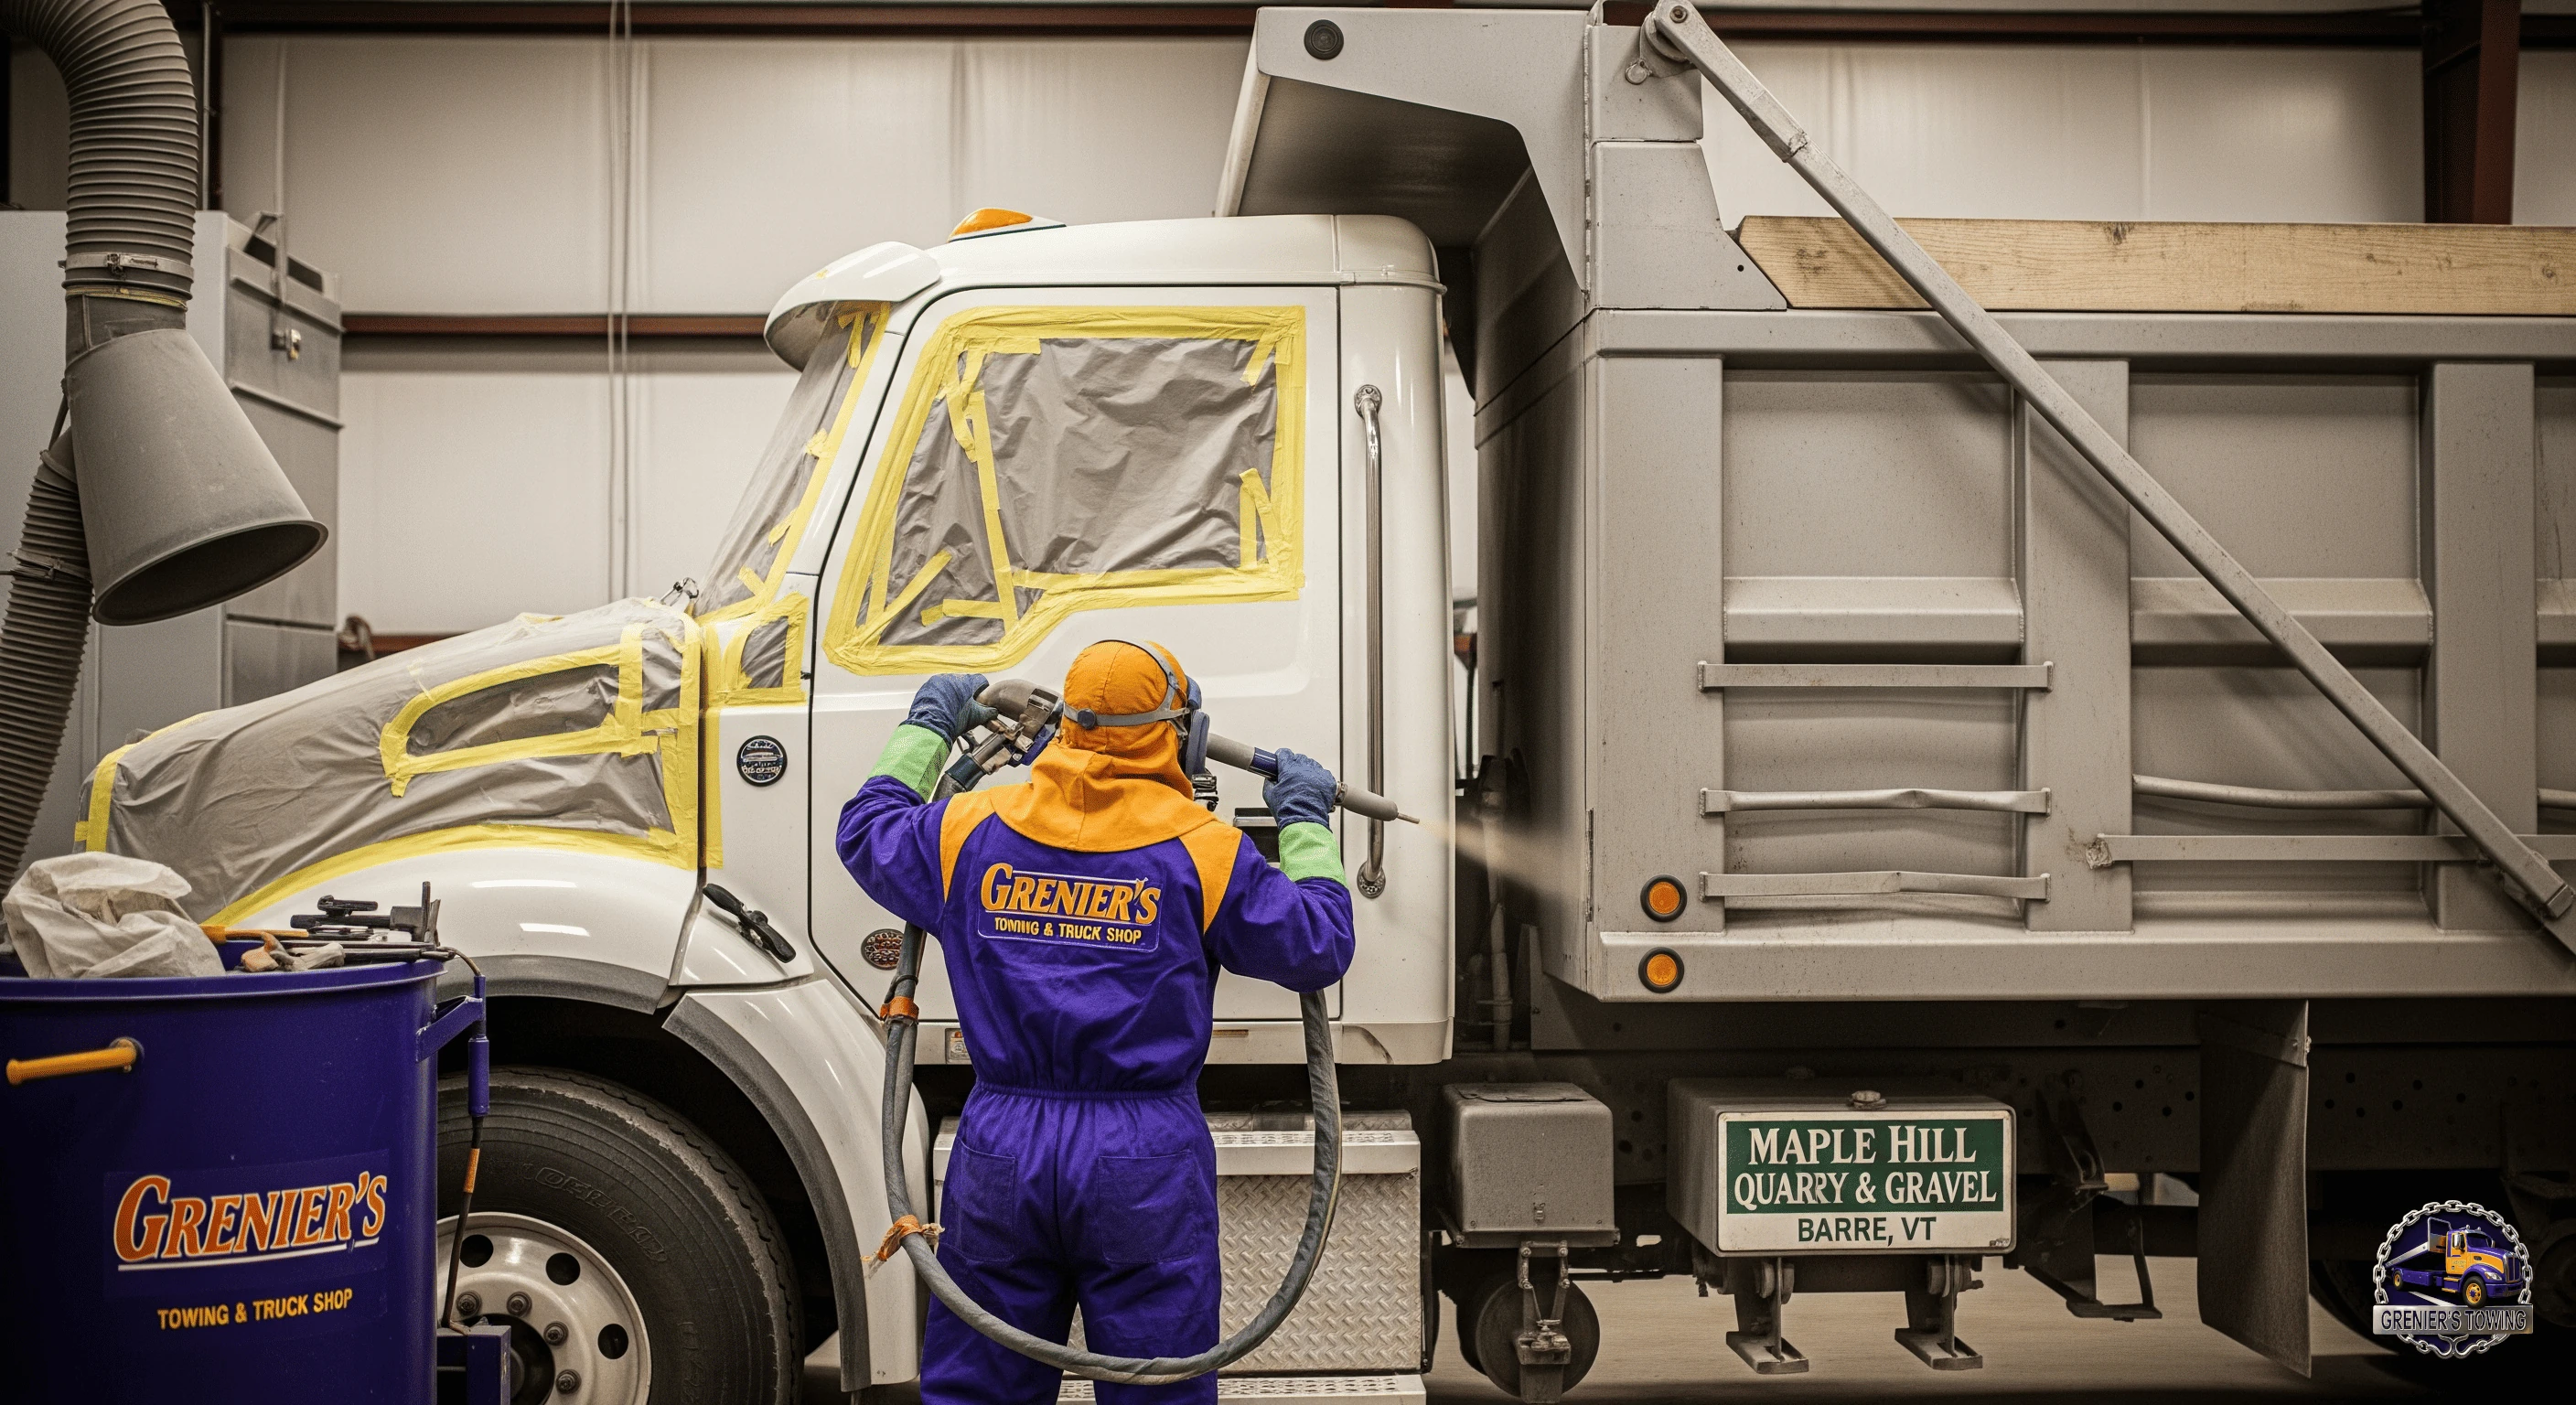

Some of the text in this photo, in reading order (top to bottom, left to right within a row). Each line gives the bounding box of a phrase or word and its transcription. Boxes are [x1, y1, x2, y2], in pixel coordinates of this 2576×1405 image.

[981, 863, 1162, 925] GRENIER'S
[1044, 922, 1054, 937] &
[1058, 923, 1102, 940] TRUCK
[1106, 927, 1143, 944] SHOP
[1748, 1125, 1977, 1165] MAPLE HILL
[1734, 1170, 1997, 1210] QUARRY & GRAVEL
[113, 1171, 387, 1262] GRENIER'S
[1798, 1217, 1937, 1247] BARRE, VT
[156, 1288, 353, 1330] TOWING & TRUCK SHOP
